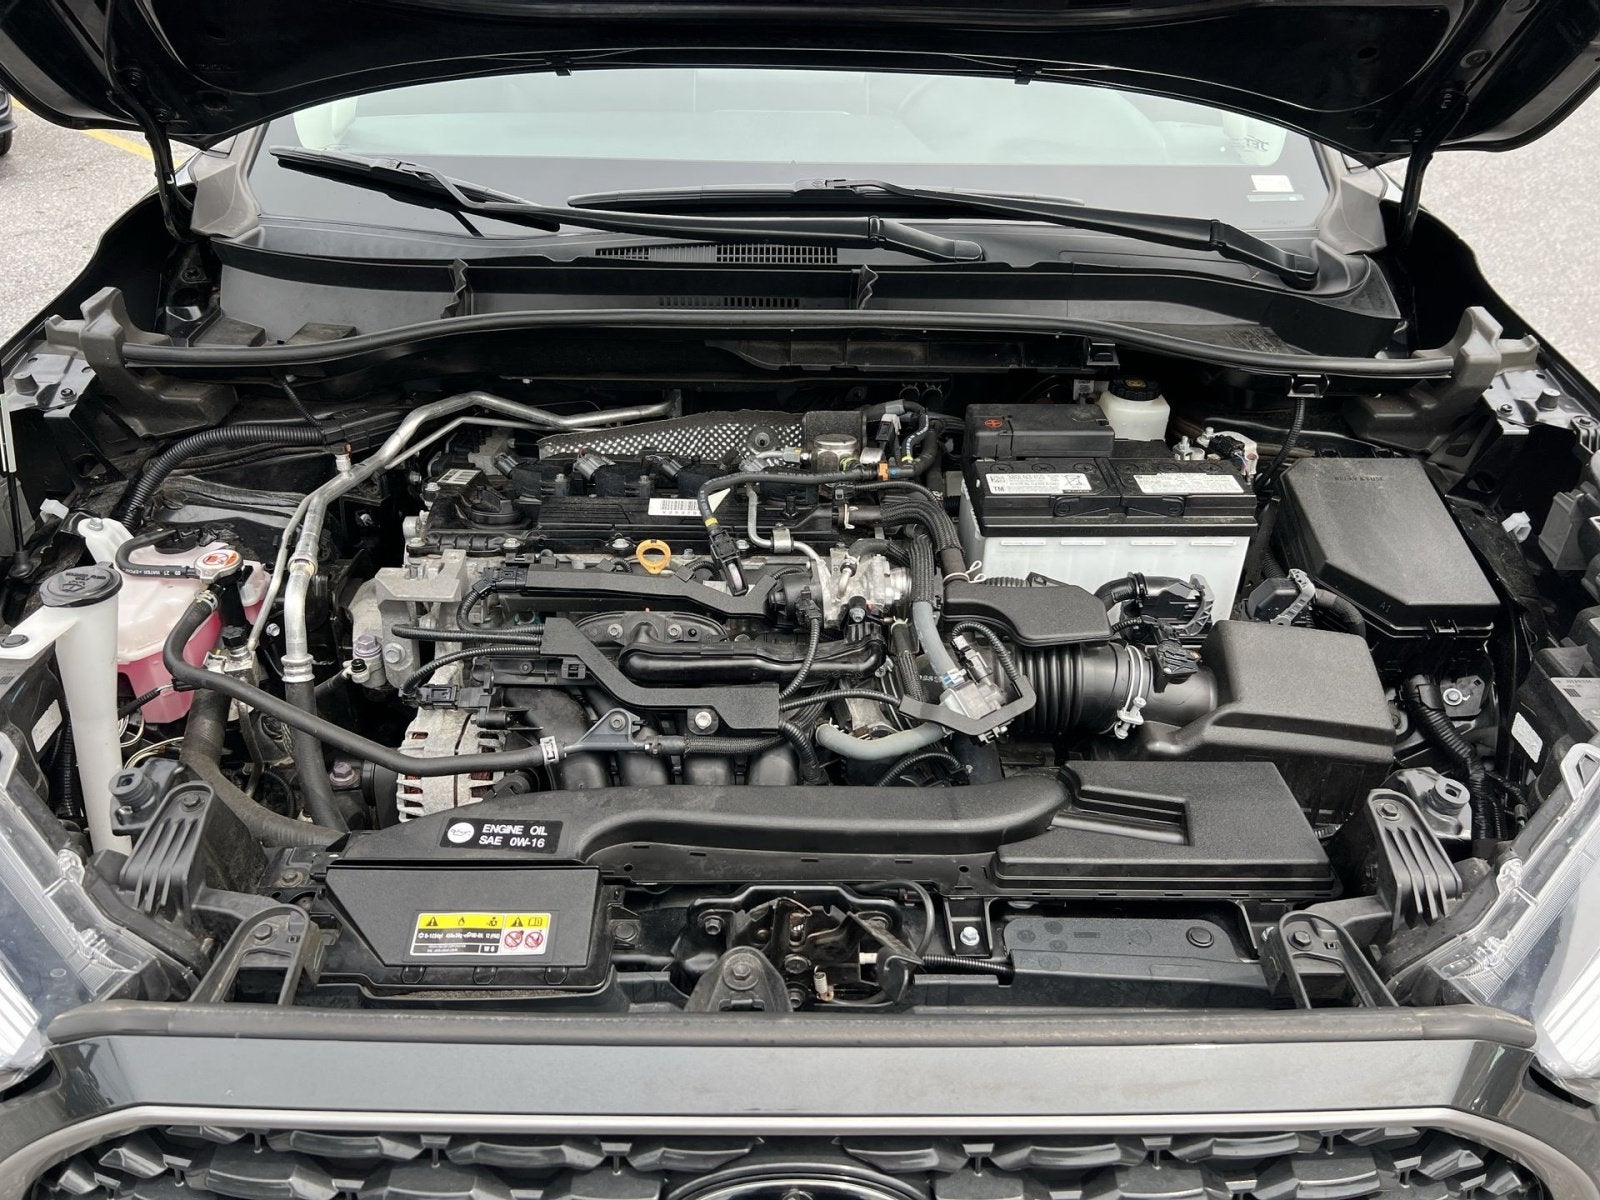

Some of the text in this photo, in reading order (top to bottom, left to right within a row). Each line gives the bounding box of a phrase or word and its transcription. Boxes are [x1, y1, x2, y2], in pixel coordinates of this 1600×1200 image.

[482, 824, 548, 836] ENGINE OIL
[478, 835, 545, 848] SAE 0W-16
